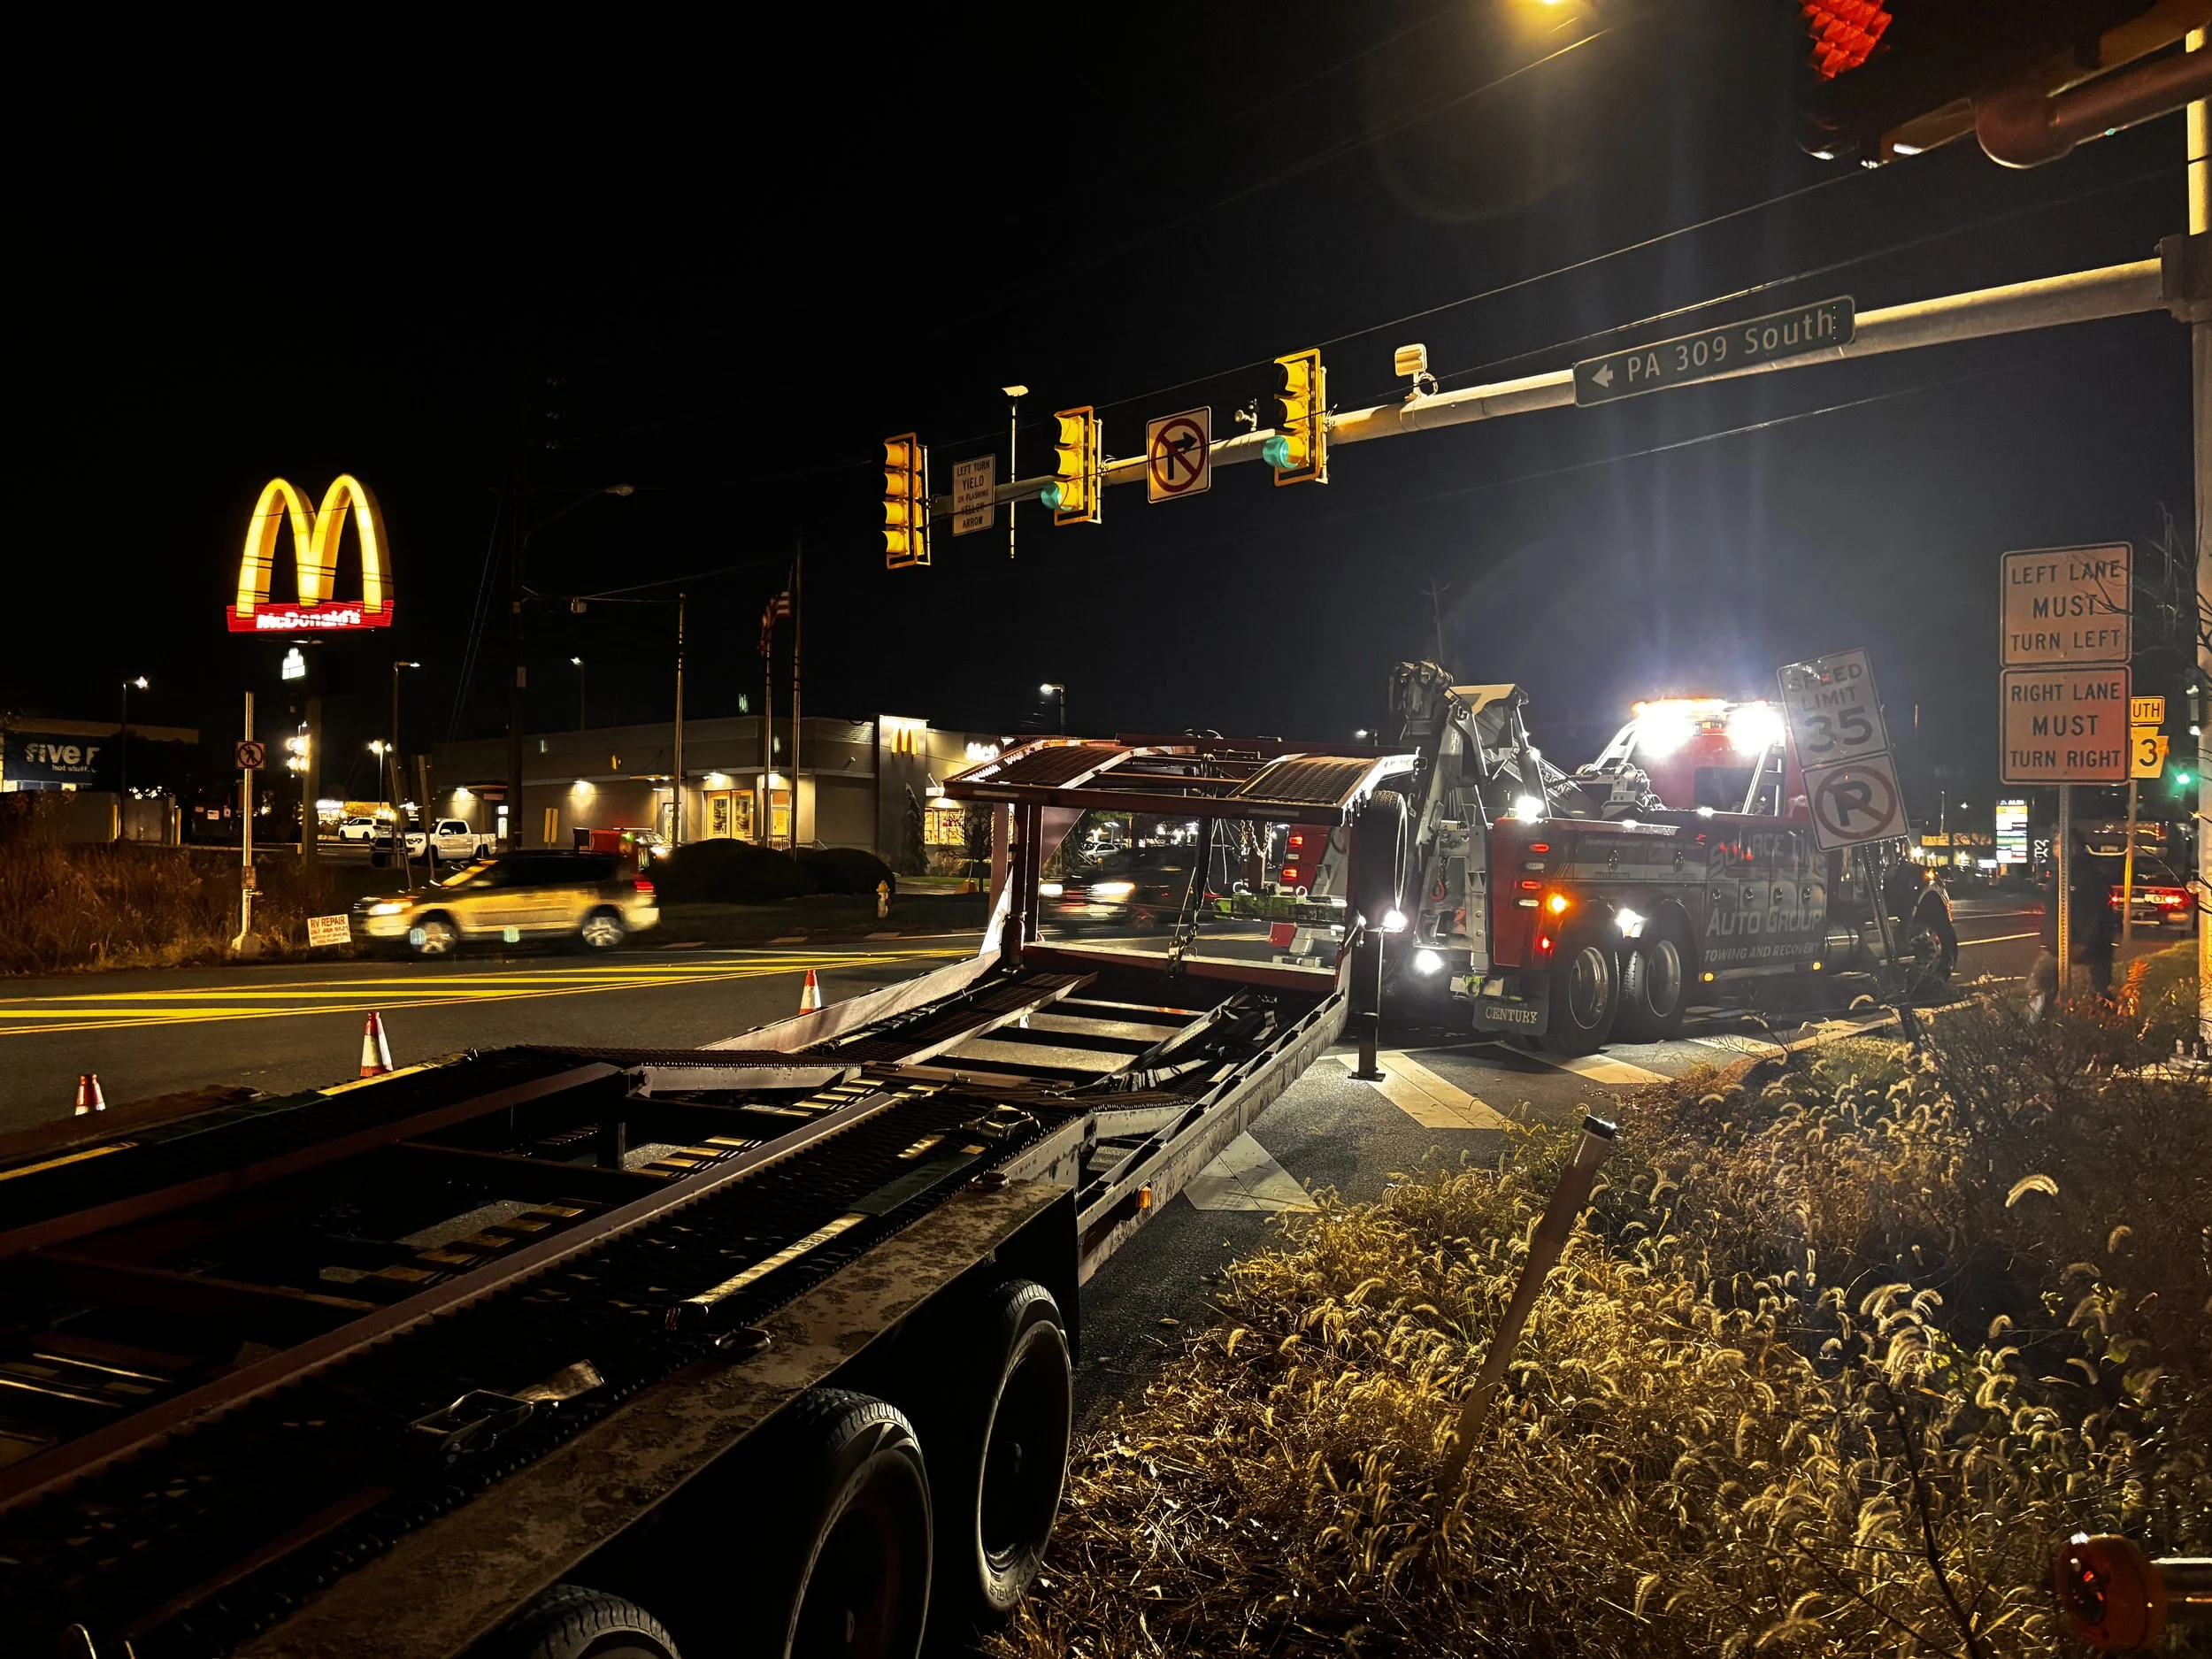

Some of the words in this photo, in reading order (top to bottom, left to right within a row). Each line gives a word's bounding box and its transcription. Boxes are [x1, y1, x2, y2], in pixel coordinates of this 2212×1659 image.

[1627, 351, 1661, 382] PA
[1675, 335, 1727, 371] 309
[1744, 309, 1833, 355] South
[956, 465, 972, 477] LEFT
[974, 460, 990, 472] TURN
[962, 475, 985, 491] YIELD
[963, 516, 984, 528] ARROW
[2012, 565, 2058, 585] LEFT
[2069, 560, 2121, 581] LANE
[2032, 594, 2098, 619] MUST
[257, 610, 361, 629] McDonald's
[2010, 633, 2061, 652] TURN
[2073, 629, 2121, 649] LEFT
[1801, 685, 1857, 710] LIMIT
[2011, 684, 2064, 702] RIGHT
[2073, 682, 2121, 701] LANE
[2132, 703, 2161, 718] UTH
[1803, 706, 1873, 753] 35
[2032, 715, 2099, 737] MUST
[2009, 749, 2056, 768] TURN
[2066, 749, 2121, 768] RIGHT
[2139, 738, 2158, 767] 3
[311, 918, 319, 927] RV
[321, 917, 345, 926] REPAIR
[1706, 907, 1761, 937] AUTO
[1766, 905, 1823, 933] GROUP
[1704, 947, 1747, 963] TOWING
[1748, 945, 1770, 958] AND
[1771, 941, 1820, 957] RECOVERY
[1485, 1006, 1538, 1024] CENTURY
